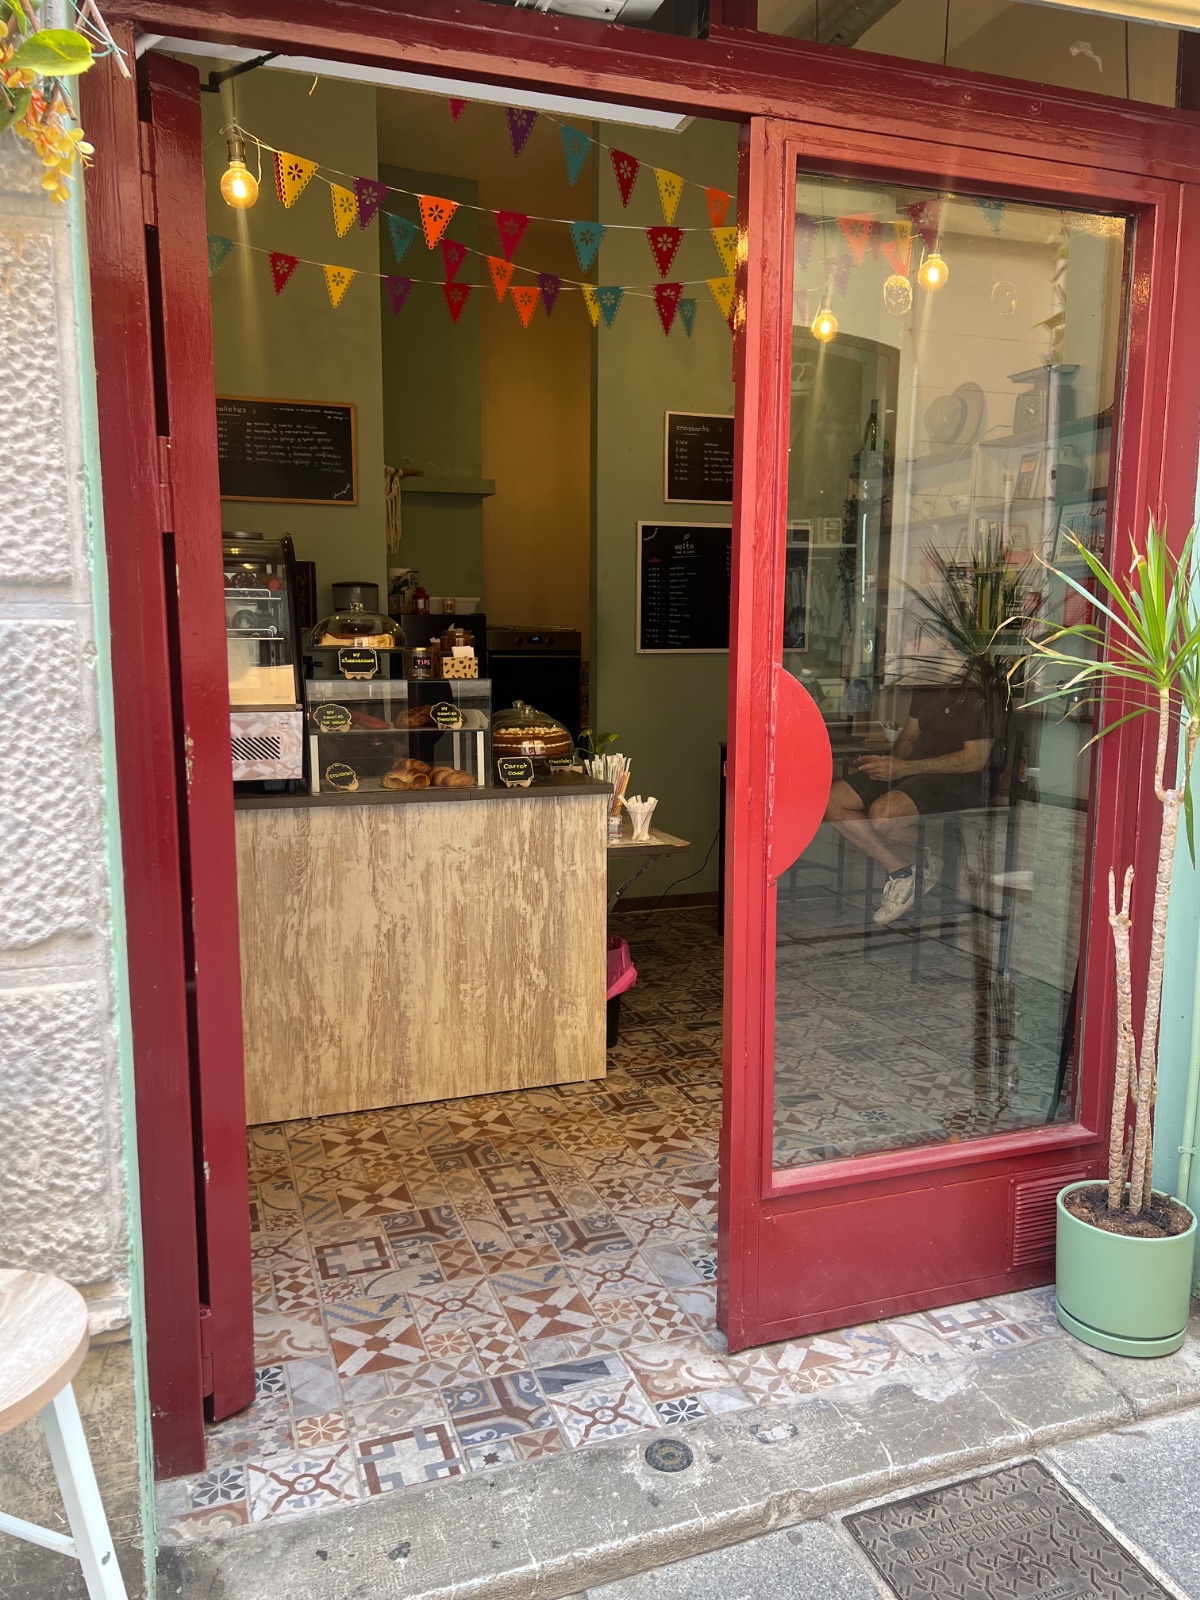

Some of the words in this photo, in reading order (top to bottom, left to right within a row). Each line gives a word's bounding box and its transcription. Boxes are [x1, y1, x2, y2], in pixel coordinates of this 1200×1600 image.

[674, 541, 694, 550] xeito
[906, 1506, 1053, 1564] ABASTECIMIENTO
[919, 1502, 1016, 1541] EMASAGRA
